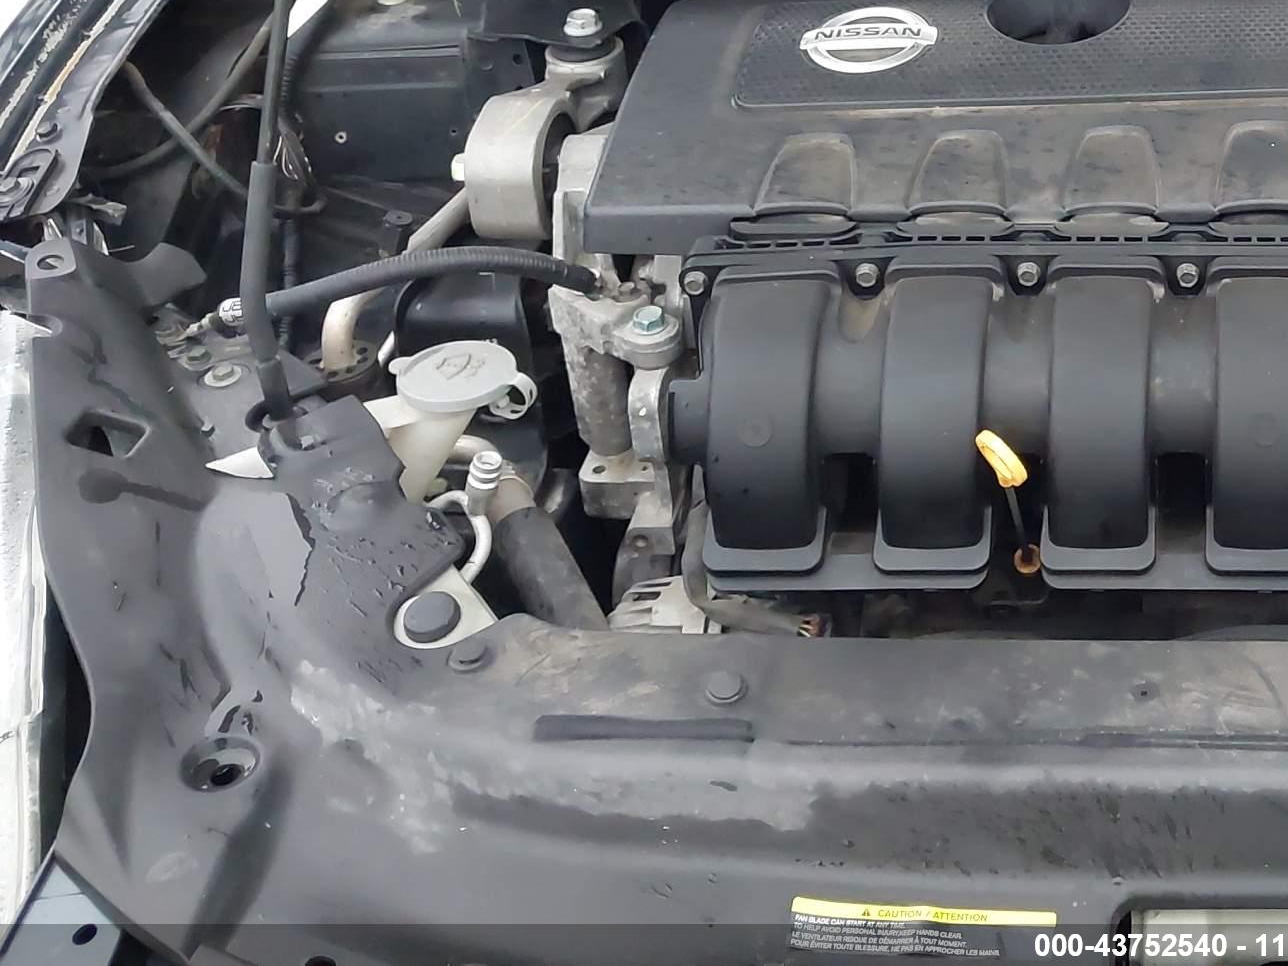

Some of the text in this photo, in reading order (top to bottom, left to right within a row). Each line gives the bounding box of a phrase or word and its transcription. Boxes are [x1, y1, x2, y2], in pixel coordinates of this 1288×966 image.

[814, 27, 922, 40] NISSAN
[795, 914, 808, 922] FAN
[808, 916, 830, 925] BLADE
[878, 909, 922, 919] CAUTION
[932, 911, 988, 922] ATTENTION
[803, 923, 820, 931] HELP
[821, 925, 841, 933] AVOID
[841, 927, 876, 935] PERSONAL
[801, 932, 842, 942] VENTILATEUR
[790, 938, 809, 948] POUR
[833, 943, 854, 951] TOUTE
[924, 946, 965, 955] APPROCHER
